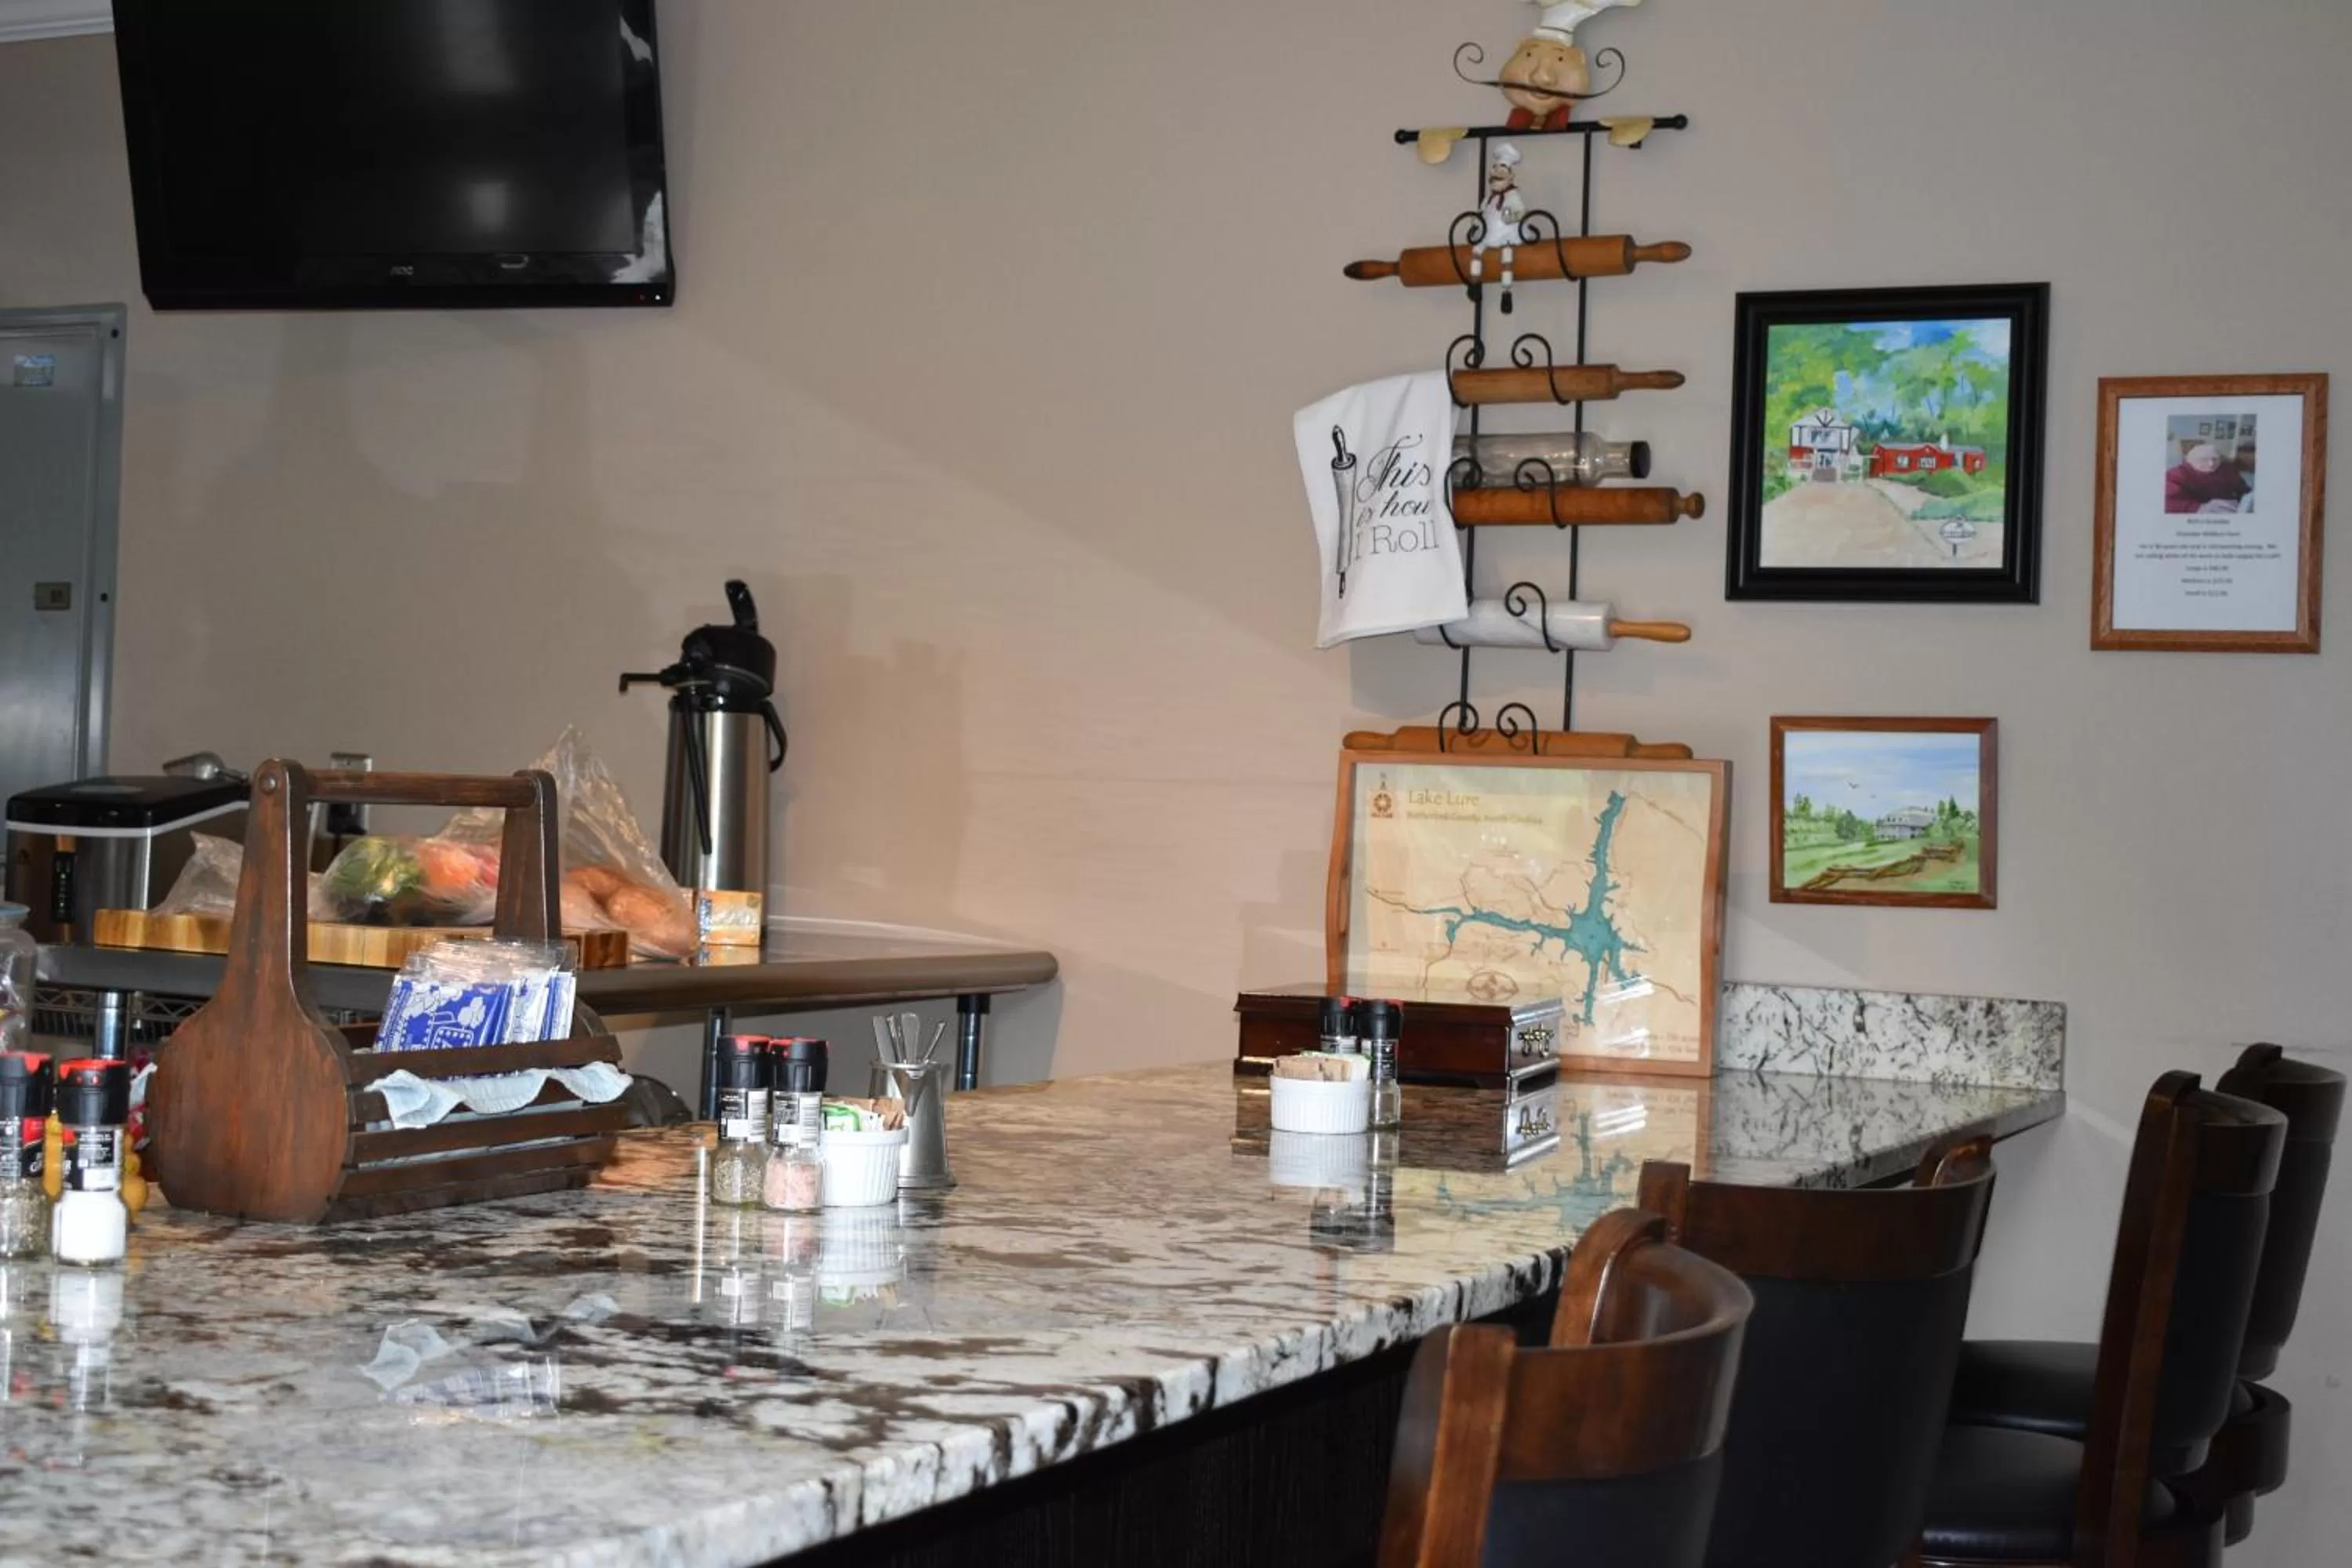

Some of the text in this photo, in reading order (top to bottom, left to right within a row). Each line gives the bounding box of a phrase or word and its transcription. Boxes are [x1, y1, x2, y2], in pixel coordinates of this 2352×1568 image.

[1356, 434, 1431, 503] This
[1370, 519, 1439, 554] Roll
[1409, 789, 1480, 807] Lake Lure
